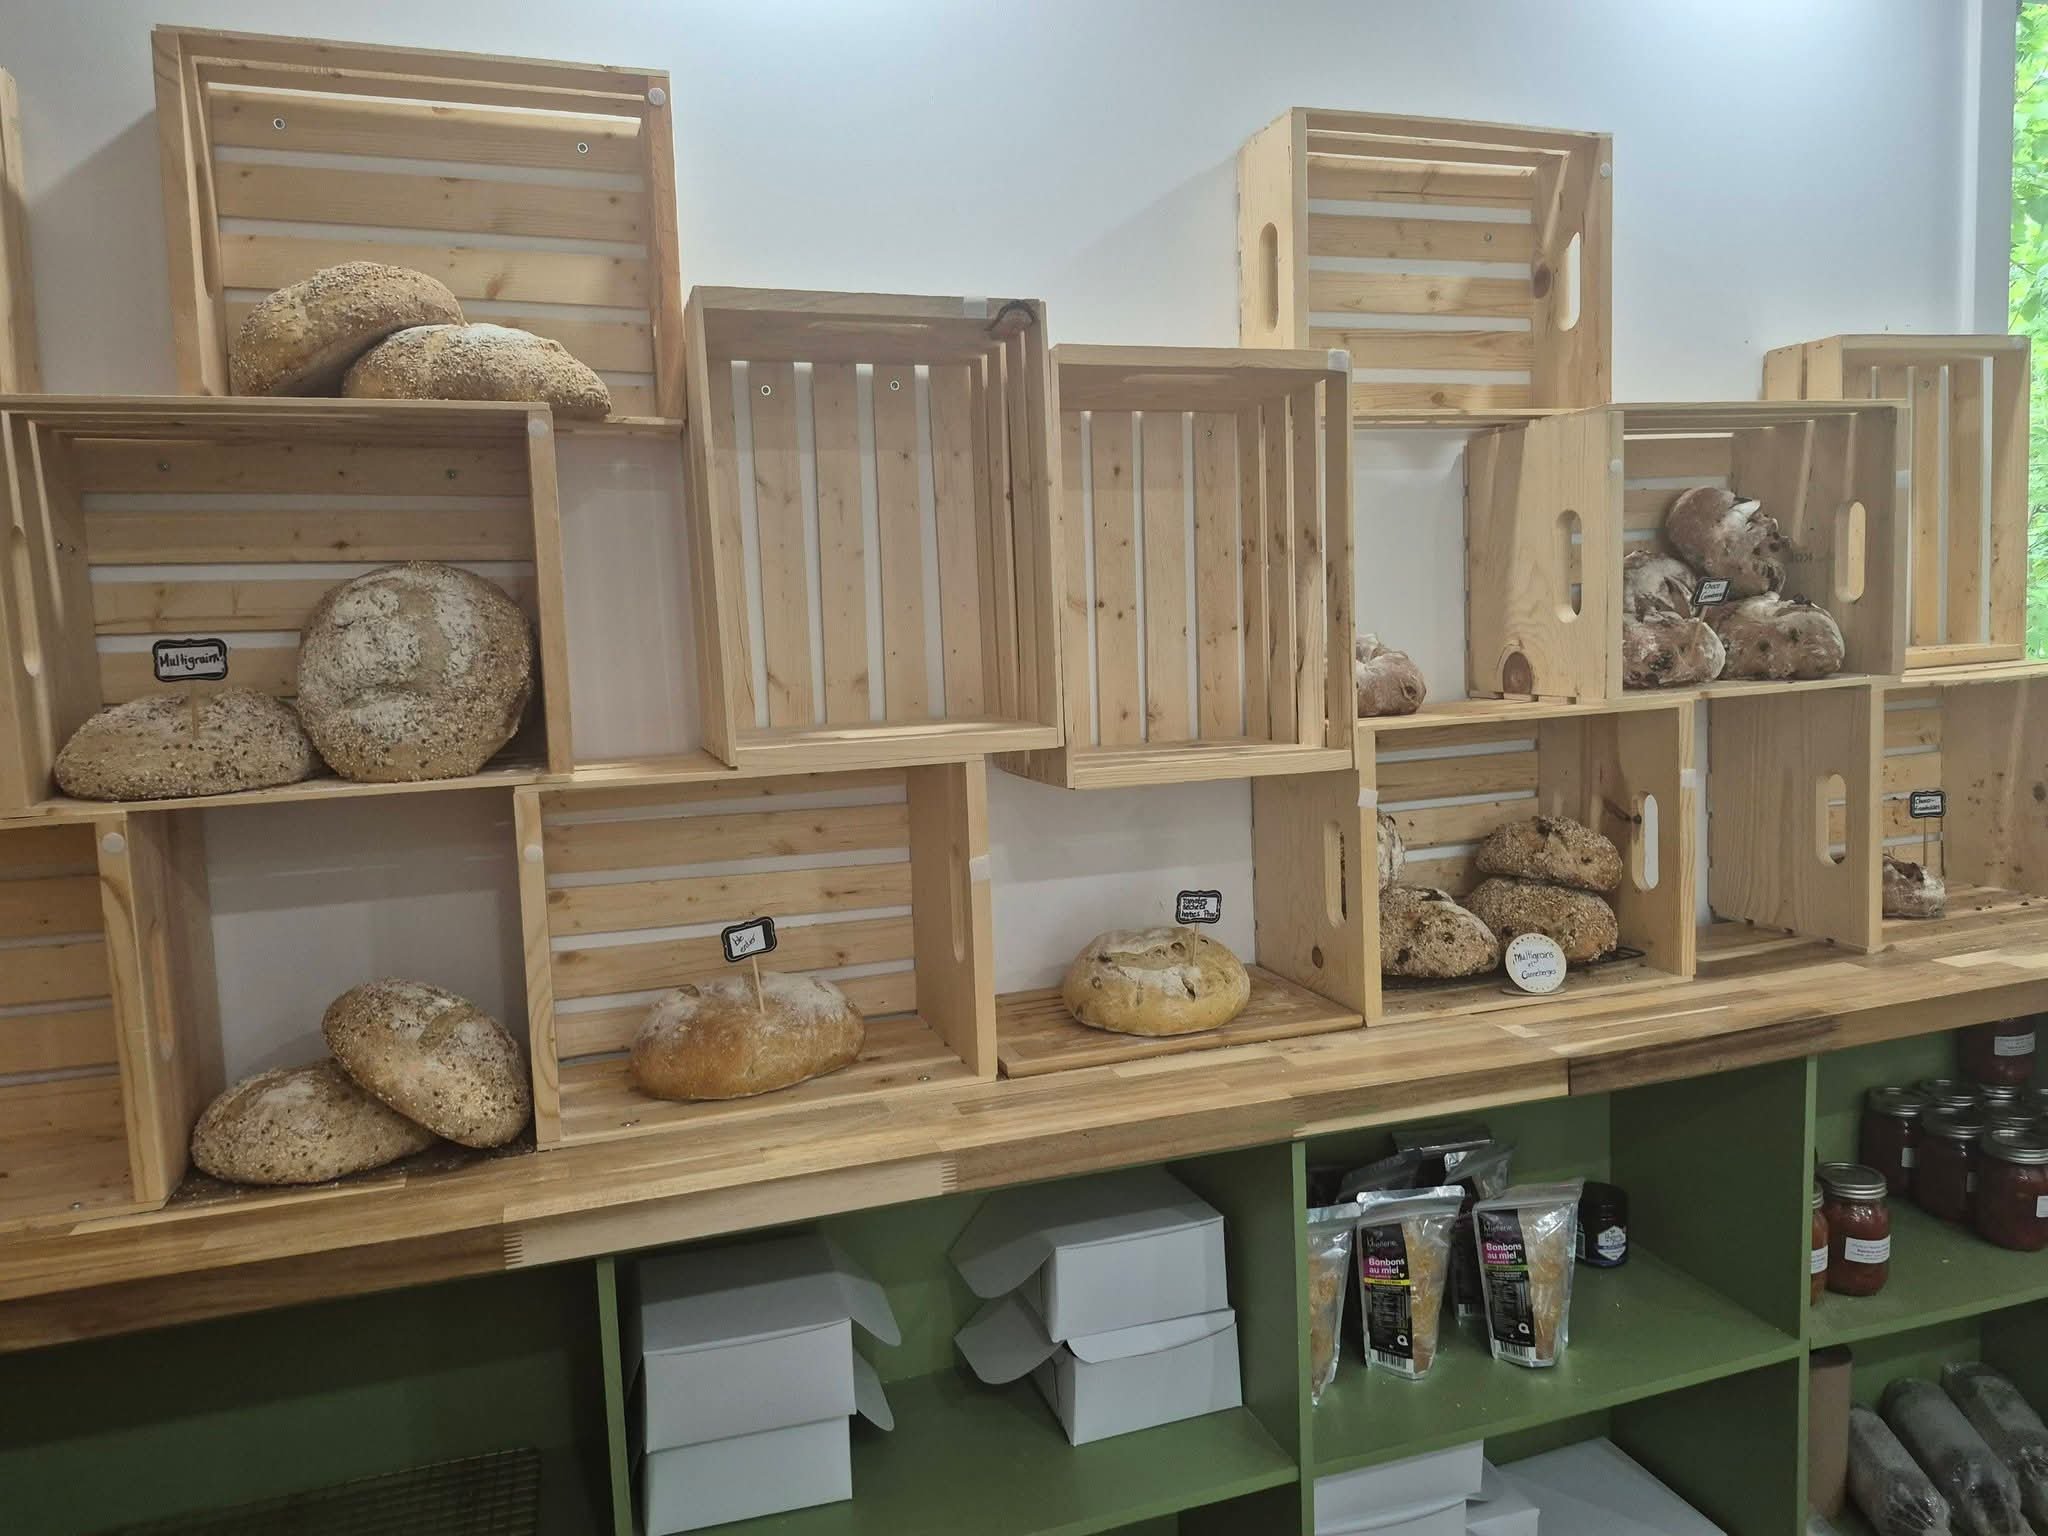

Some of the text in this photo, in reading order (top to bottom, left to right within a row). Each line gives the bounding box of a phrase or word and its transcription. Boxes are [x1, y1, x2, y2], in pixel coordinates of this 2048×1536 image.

[1486, 1242, 1522, 1252] Bonbons
[1499, 1251, 1517, 1260] miel
[1368, 1257, 1405, 1267] Bonbons
[1369, 1265, 1399, 1275] au miel
